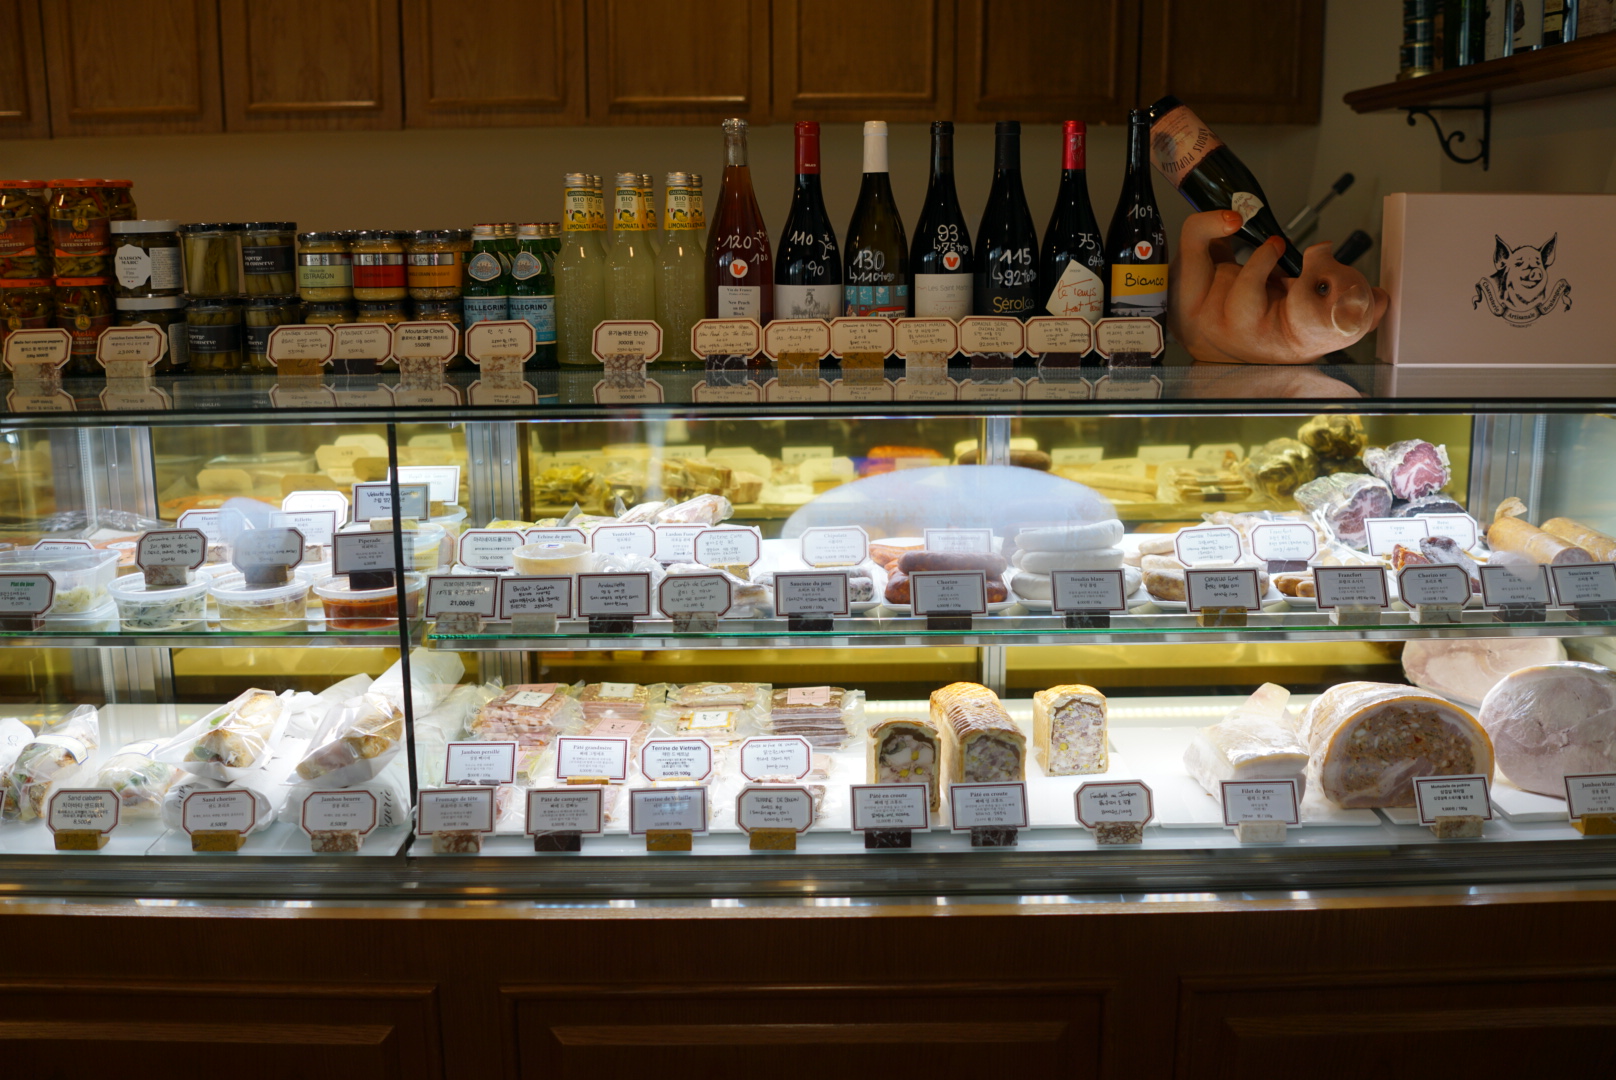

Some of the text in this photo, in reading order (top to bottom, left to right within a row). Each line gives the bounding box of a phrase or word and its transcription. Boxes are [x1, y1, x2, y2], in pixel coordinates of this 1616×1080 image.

[1161, 127, 1209, 174] ARBOIS PUPILLIN
[1126, 203, 1153, 220] 109
[70, 230, 95, 240] Melis
[790, 230, 814, 246] 110
[937, 224, 959, 242] 93
[721, 234, 752, 249] 120
[941, 242, 956, 254] 75
[1077, 232, 1096, 251] 75
[749, 253, 769, 265] 100
[852, 249, 885, 272] 130
[999, 247, 1031, 265] 115
[303, 272, 335, 280] ESTRAGON
[807, 260, 825, 277] 90
[1004, 269, 1022, 286] 92
[1124, 272, 1164, 288] Bianco
[927, 284, 955, 292] Les Saint
[993, 296, 1025, 313] Sérol
[1482, 281, 1500, 313] Charcuterie
[1543, 282, 1566, 313] Boulangerie
[1508, 311, 1536, 320] Artisanale
[357, 537, 382, 545] Piperade
[671, 579, 692, 589] Confit
[820, 580, 833, 588] jour
[449, 599, 477, 607] 21,000원
[1581, 781, 1602, 789] Jambon
[435, 796, 459, 804] Fromage
[560, 796, 589, 804] campagne
